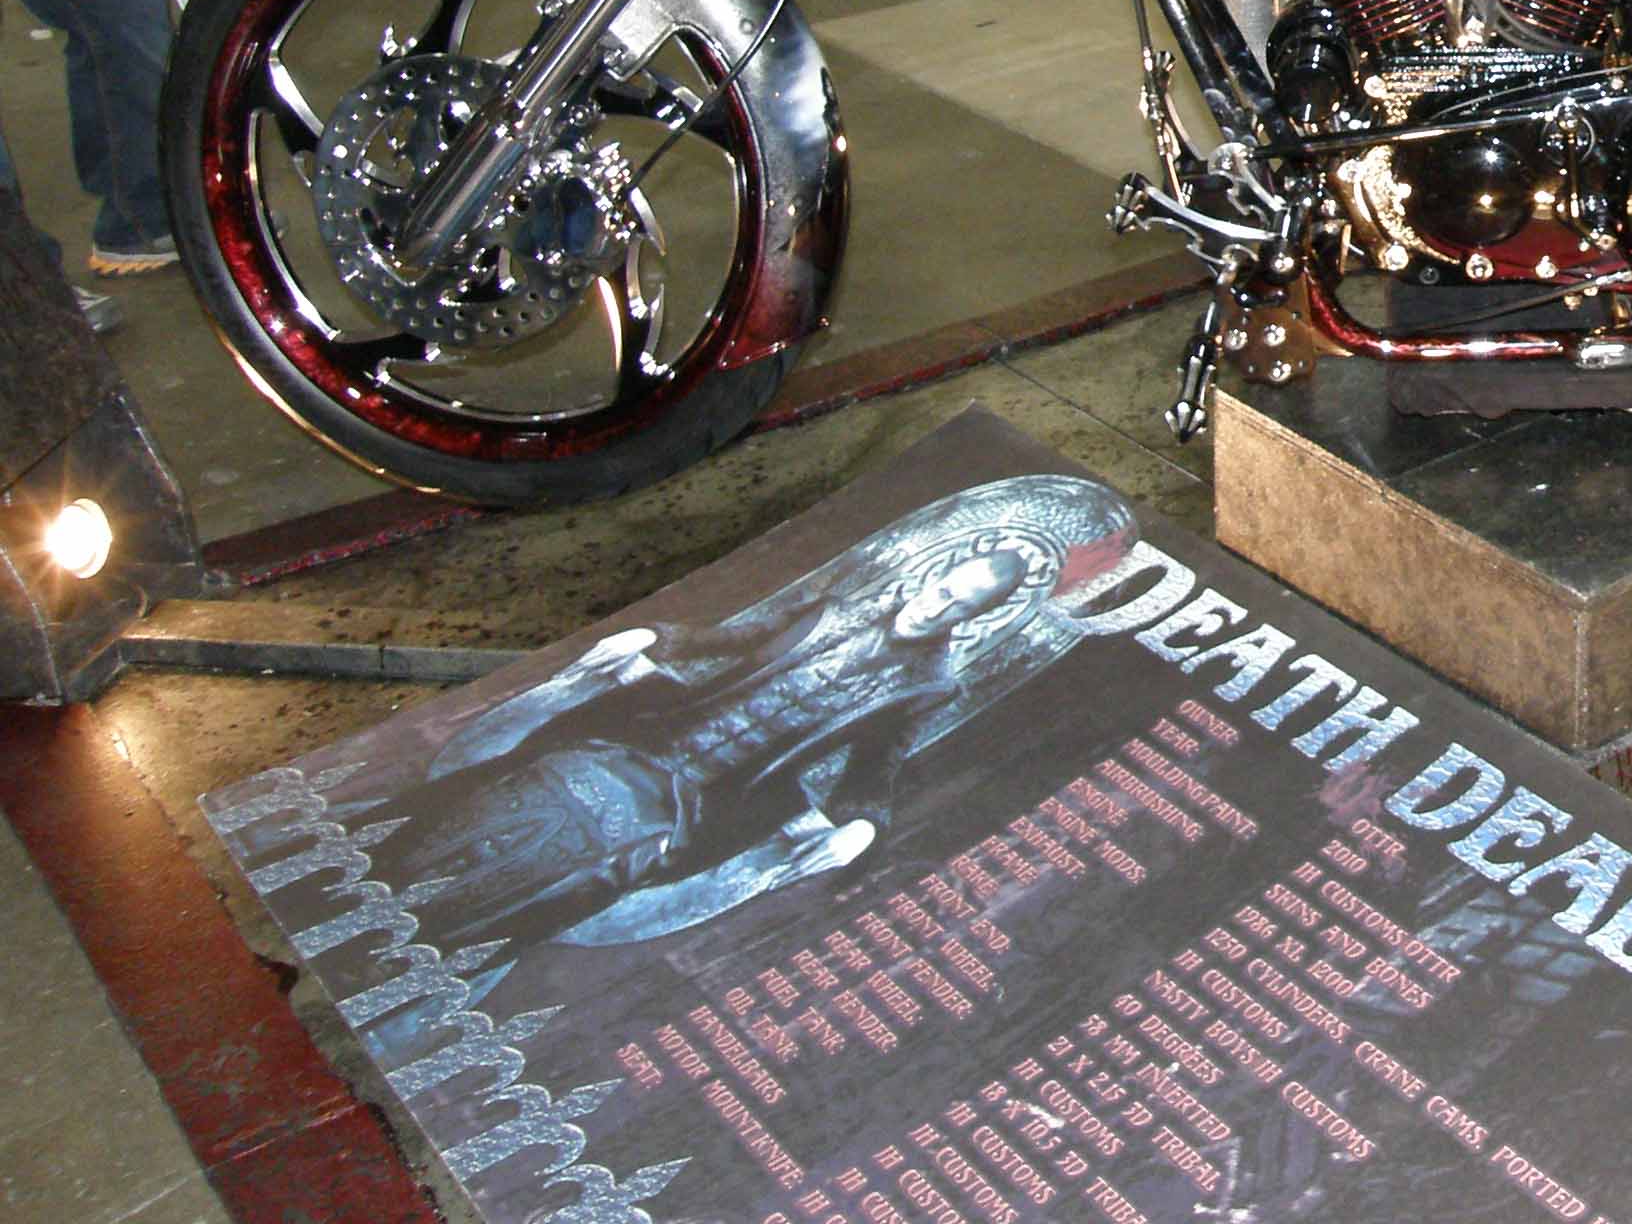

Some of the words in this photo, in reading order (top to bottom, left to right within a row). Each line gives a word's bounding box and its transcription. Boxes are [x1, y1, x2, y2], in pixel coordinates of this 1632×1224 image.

[1056, 540, 1419, 776] DEATH
[1152, 718, 1199, 757] YEAR:
[1179, 700, 1238, 744] OWNER:
[1039, 797, 1099, 843] ENGINE
[1095, 840, 1145, 883] MODS:
[1096, 760, 1202, 841] AIRBRUSHING:
[1352, 819, 1405, 861] OTTR
[1009, 816, 1085, 878] EXHAUST:
[1322, 840, 1368, 872] 2010
[888, 893, 944, 939] FRONT
[940, 938, 996, 991] WHEEL:
[919, 873, 976, 918] FRONT
[969, 918, 1010, 954] END:
[1235, 906, 1277, 938] 1986
[1275, 936, 1305, 962] XL
[1307, 960, 1359, 997] 1200
[1264, 884, 1322, 927] SKINS
[1320, 925, 1366, 958] AND
[1365, 957, 1433, 1008] BONES
[792, 950, 839, 990] REAR
[832, 990, 897, 1053] FENDER:
[824, 931, 872, 971] REAR
[864, 970, 922, 1025] WHEEL:
[856, 912, 912, 958] FRONT
[903, 958, 972, 1019] FENDER:
[1202, 970, 1288, 1038] CUSTOMS
[656, 1024, 710, 1078] MOTOR
[726, 987, 755, 1016] OIL
[751, 1014, 799, 1062] TANK:
[757, 968, 800, 1008] FUEL
[796, 1006, 845, 1054] TANK:
[1114, 994, 1143, 1016] 40
[1139, 1015, 1224, 1084] DEGREES
[617, 1043, 662, 1088] SEAT:
[688, 1006, 786, 1103] HANDELBARS
[1080, 1014, 1108, 1036] 58
[1104, 1034, 1141, 1064] MM
[1136, 1063, 1230, 1140] INVERTED
[1144, 970, 1209, 1020] NASTY
[1282, 1082, 1375, 1160] CUSTOMS
[1204, 928, 1248, 961] 1250
[1355, 1041, 1426, 1098] CRANE
[1491, 1146, 1585, 1221] PORTED
[981, 1081, 1007, 1102] 18
[1002, 1100, 1028, 1120] X
[1020, 1117, 1062, 1150] 10.5
[1056, 1151, 1088, 1176] 3D
[1040, 1080, 1125, 1155] CUSTOMS
[1048, 1036, 1074, 1057] 21
[1068, 1055, 1093, 1074] X
[1088, 1072, 1127, 1102] 2.15
[1122, 1102, 1152, 1126] 3D
[1152, 1126, 1220, 1191] TRIBAL
[800, 1190, 830, 1214] JH
[836, 1168, 867, 1192] JH
[873, 1146, 904, 1169] JH
[899, 1169, 966, 1224] CUSTO
[910, 1123, 940, 1147] JH
[934, 1147, 1018, 1224] CUSTOMS
[973, 1126, 1056, 1204] CUSTOMS
